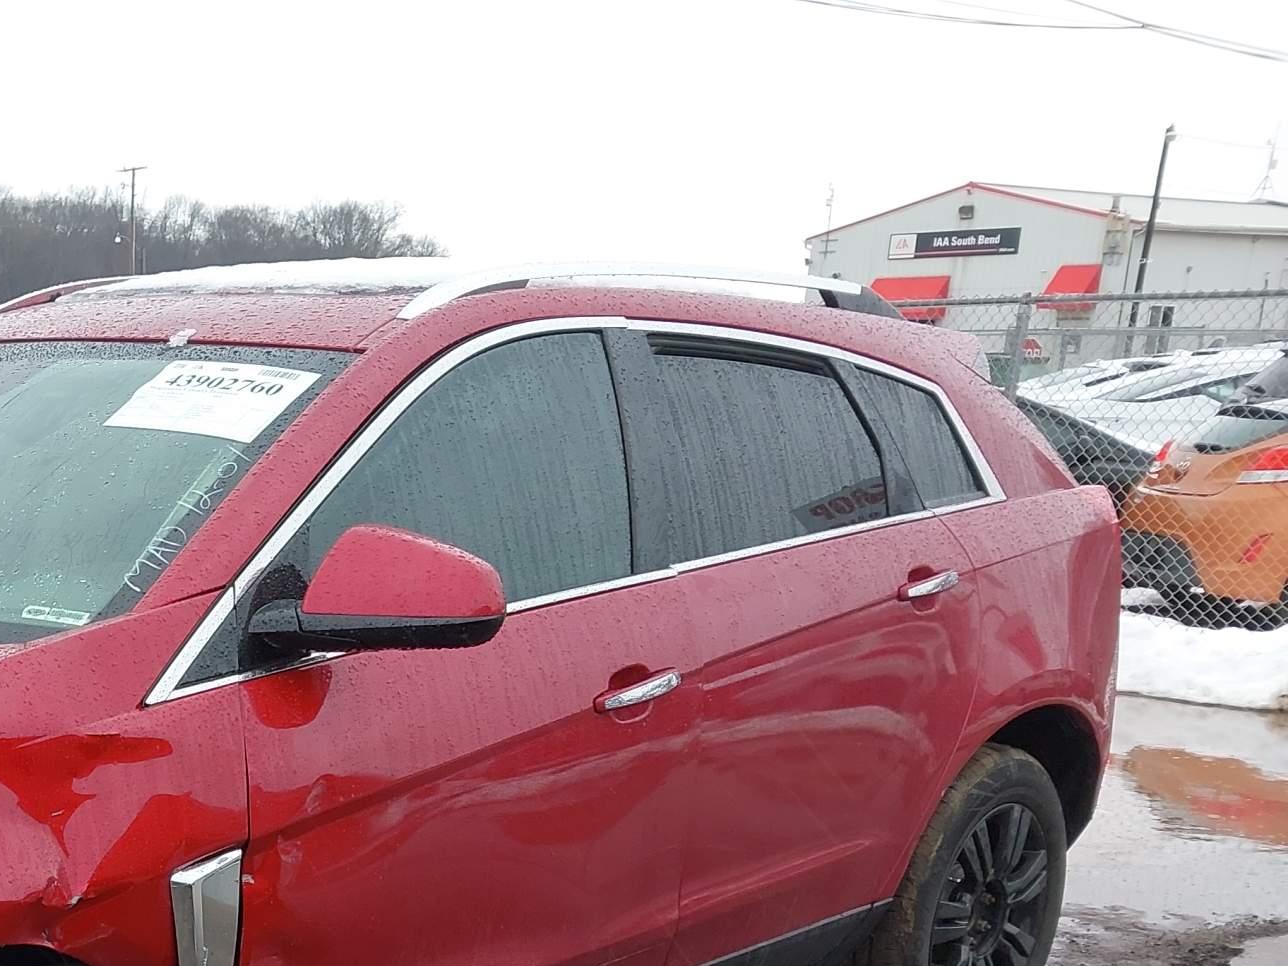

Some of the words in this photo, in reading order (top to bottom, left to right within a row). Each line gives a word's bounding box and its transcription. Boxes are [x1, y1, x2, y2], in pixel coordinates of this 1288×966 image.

[933, 237, 950, 248] IAA
[950, 235, 977, 246] South
[978, 234, 1001, 244] Bend
[164, 373, 285, 397] 43902760
